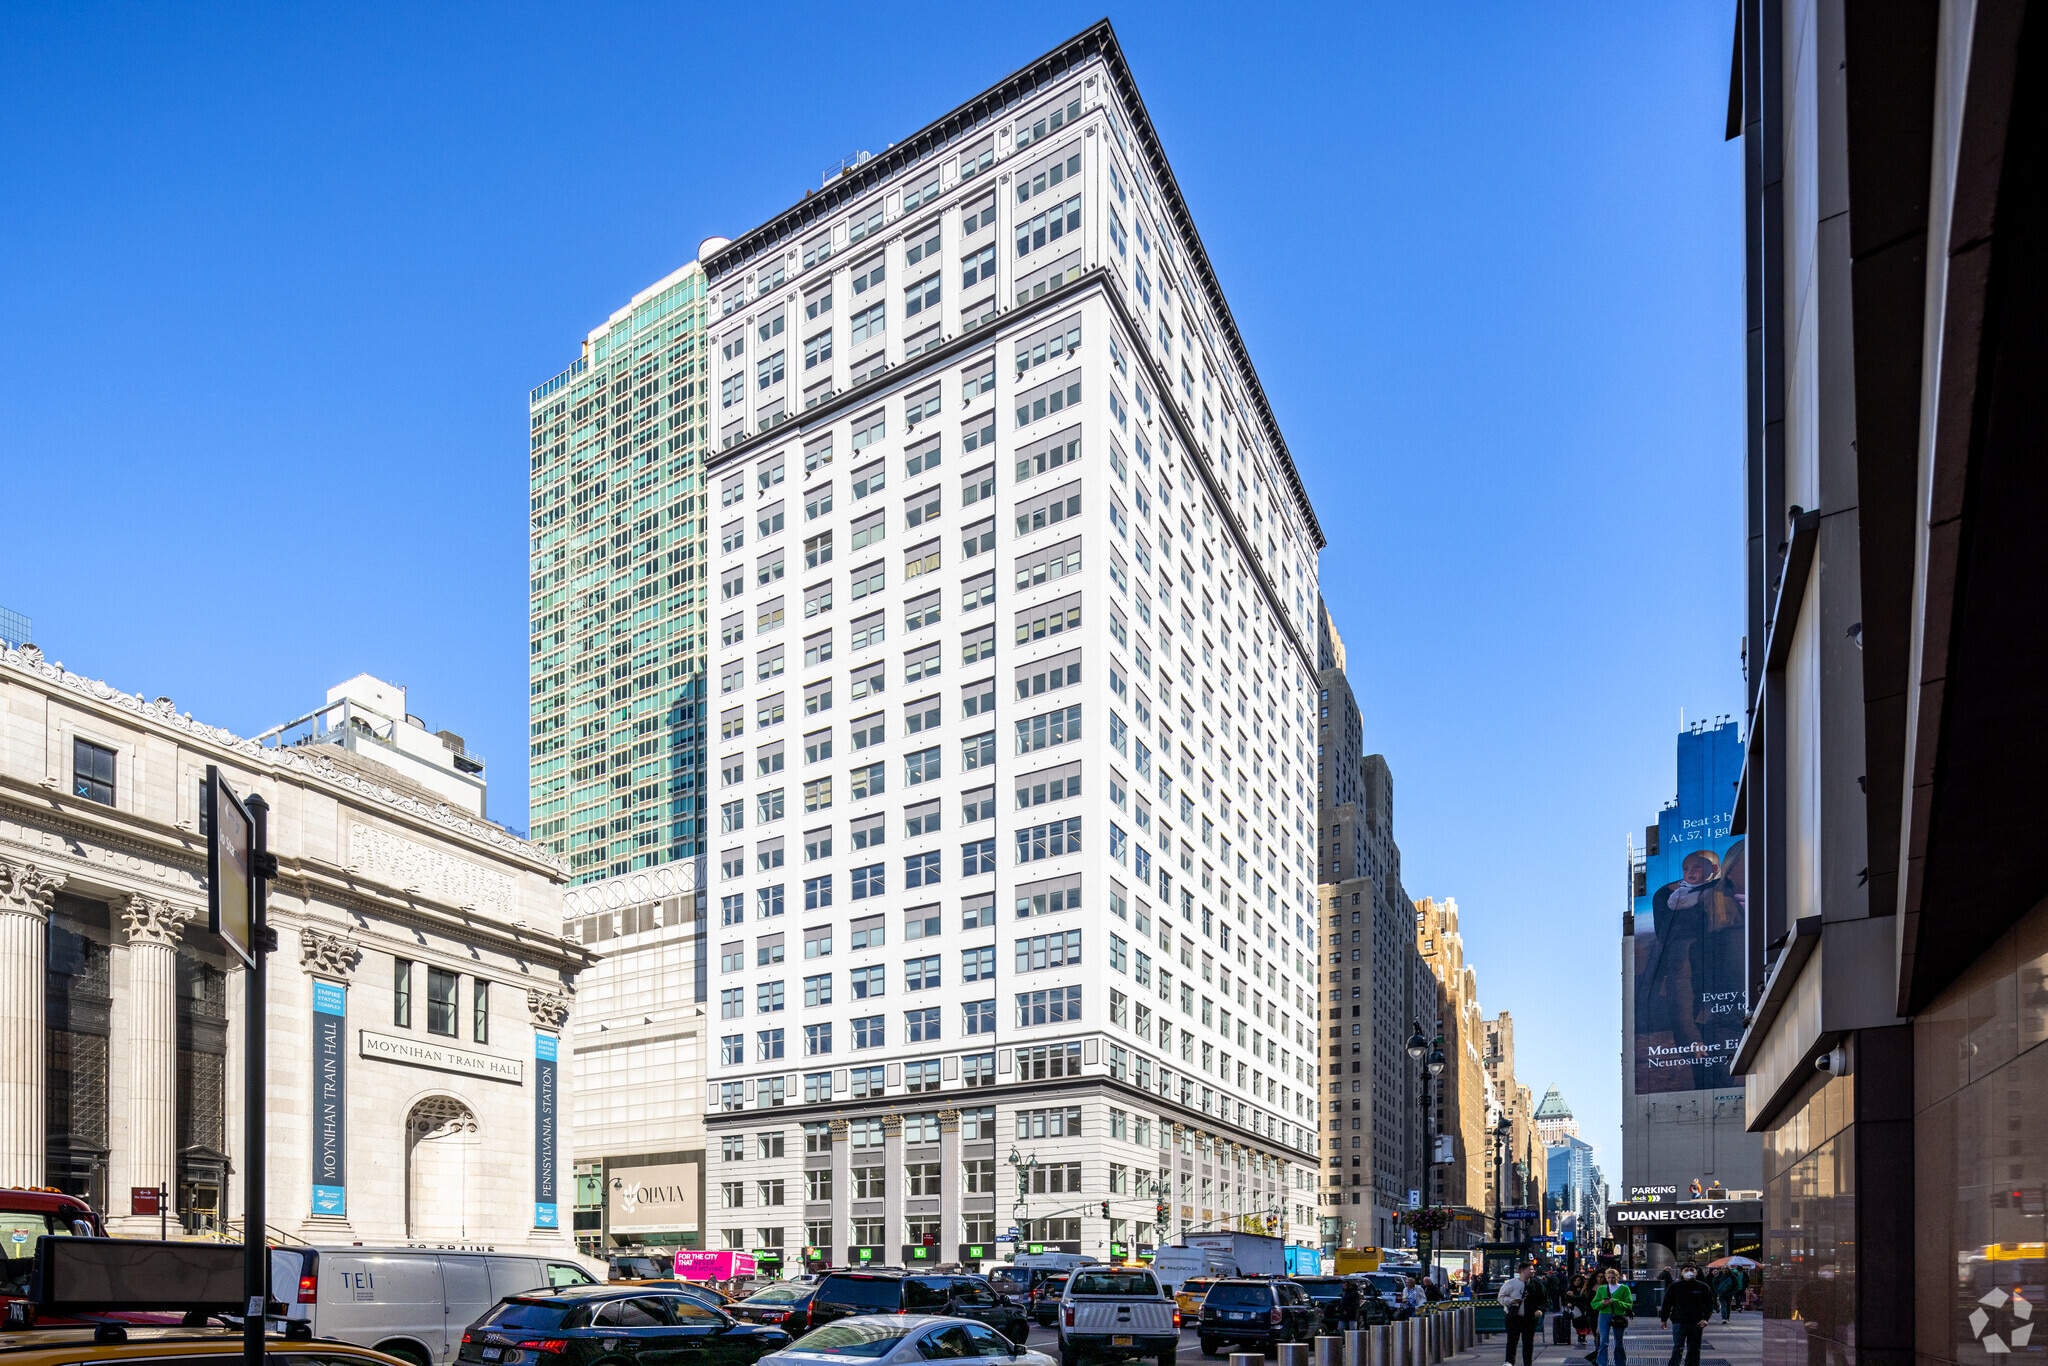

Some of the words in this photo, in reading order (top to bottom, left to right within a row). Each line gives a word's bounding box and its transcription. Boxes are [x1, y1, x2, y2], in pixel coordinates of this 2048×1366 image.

[1683, 817, 1709, 829] Beat
[1713, 814, 1720, 824] 3
[1724, 812, 1732, 822] b
[1669, 834, 1682, 844] At
[1687, 830, 1702, 840] 57,
[1707, 828, 1711, 837] I
[1715, 827, 1729, 839] ga
[317, 989, 341, 998] EMPIRE
[317, 995, 342, 1005] STATION
[1702, 991, 1738, 1002] Every
[317, 1001, 341, 1010] COMPLEX
[1711, 1003, 1734, 1014] day
[1737, 1002, 1748, 1010] to
[324, 1022, 337, 1055] HALL
[1648, 1041, 1721, 1056] Montefiore
[1725, 1038, 1739, 1050] Ei
[367, 1039, 442, 1061] MOYNIHAN
[448, 1054, 485, 1069] TRAIN
[490, 1062, 519, 1076] HALL
[324, 1058, 336, 1099] TRAIN
[542, 1066, 552, 1114] STATION
[323, 1103, 336, 1179] MOYNIHAN
[542, 1117, 552, 1197] PENNSYLVANIA
[637, 1185, 684, 1204] OLIVIA
[1631, 1185, 1676, 1195] PARKING
